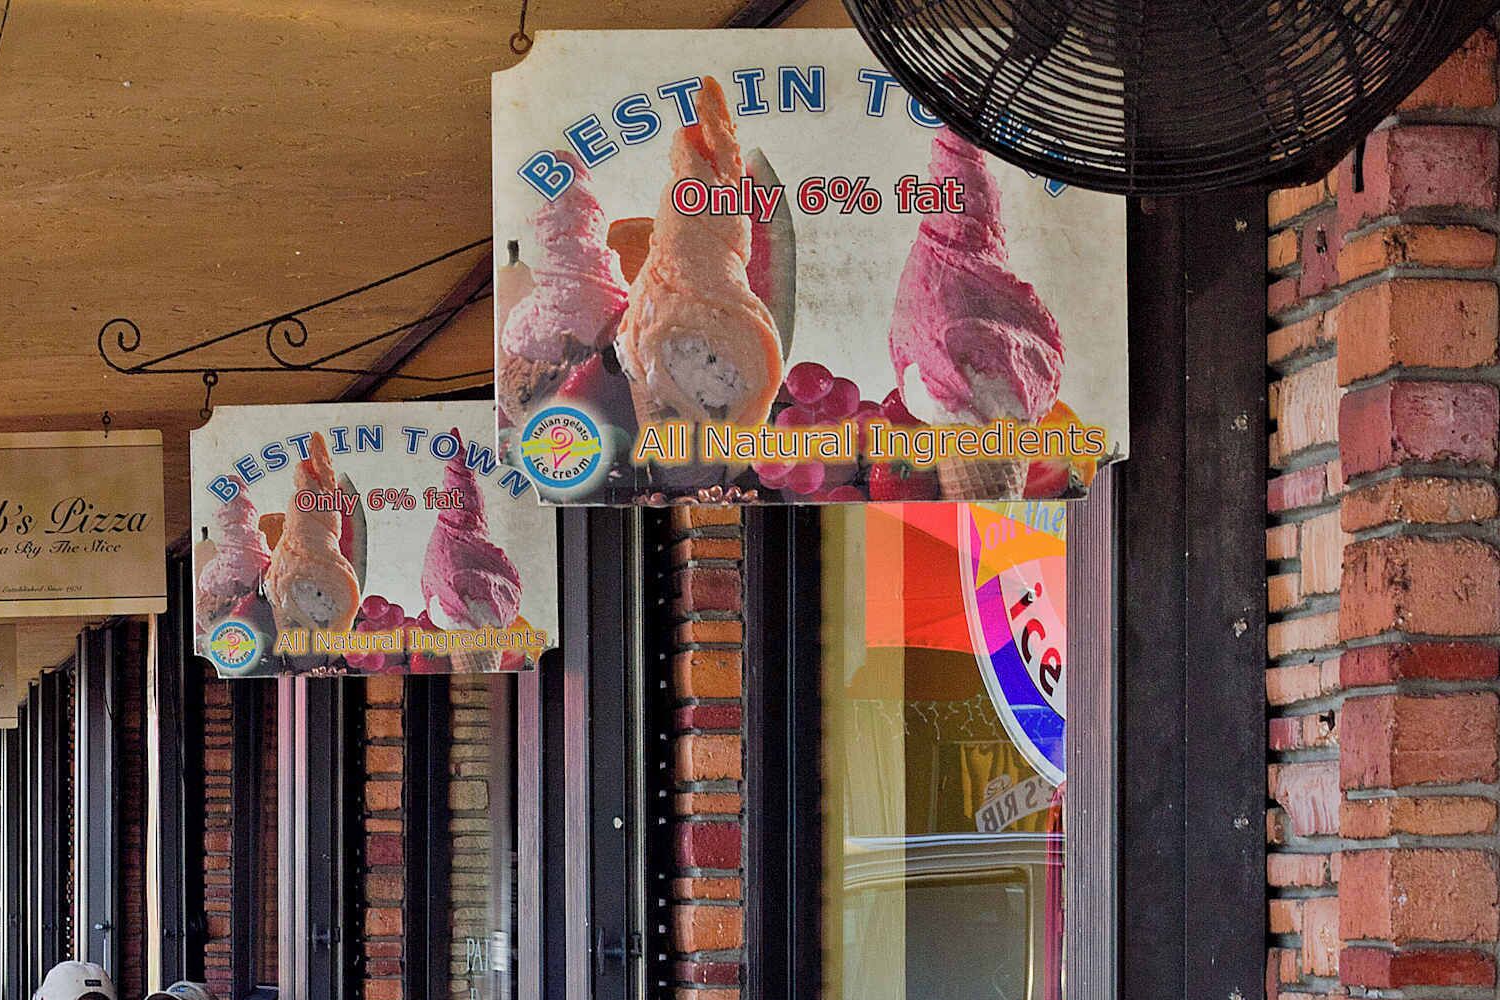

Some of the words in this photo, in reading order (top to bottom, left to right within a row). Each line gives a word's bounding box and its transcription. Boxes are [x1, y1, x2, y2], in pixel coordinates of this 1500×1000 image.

[517, 77, 703, 201] BEST
[734, 66, 826, 116] IN
[672, 177, 785, 223] Only
[797, 176, 882, 214] 6%
[895, 175, 965, 214] fat
[563, 418, 589, 442] gelato
[637, 426, 687, 459] All
[704, 424, 853, 459] Natural
[869, 423, 1104, 464] Ingredients
[207, 432, 315, 505] BEST
[329, 425, 384, 455] IN
[401, 427, 533, 499] TOWN
[533, 456, 550, 476] ice
[552, 458, 590, 479] cream
[44, 497, 153, 535] Pizza
[295, 488, 360, 516] Only
[366, 488, 417, 511] 6%
[424, 487, 465, 511] fat
[1024, 501, 1066, 533] the
[14, 541, 42, 559] By
[49, 539, 83, 555] The
[84, 539, 122, 553] Slice
[277, 632, 307, 652] All
[314, 630, 402, 652] Natural
[410, 628, 547, 654] Ingredients
[1010, 582, 1062, 697] ice
